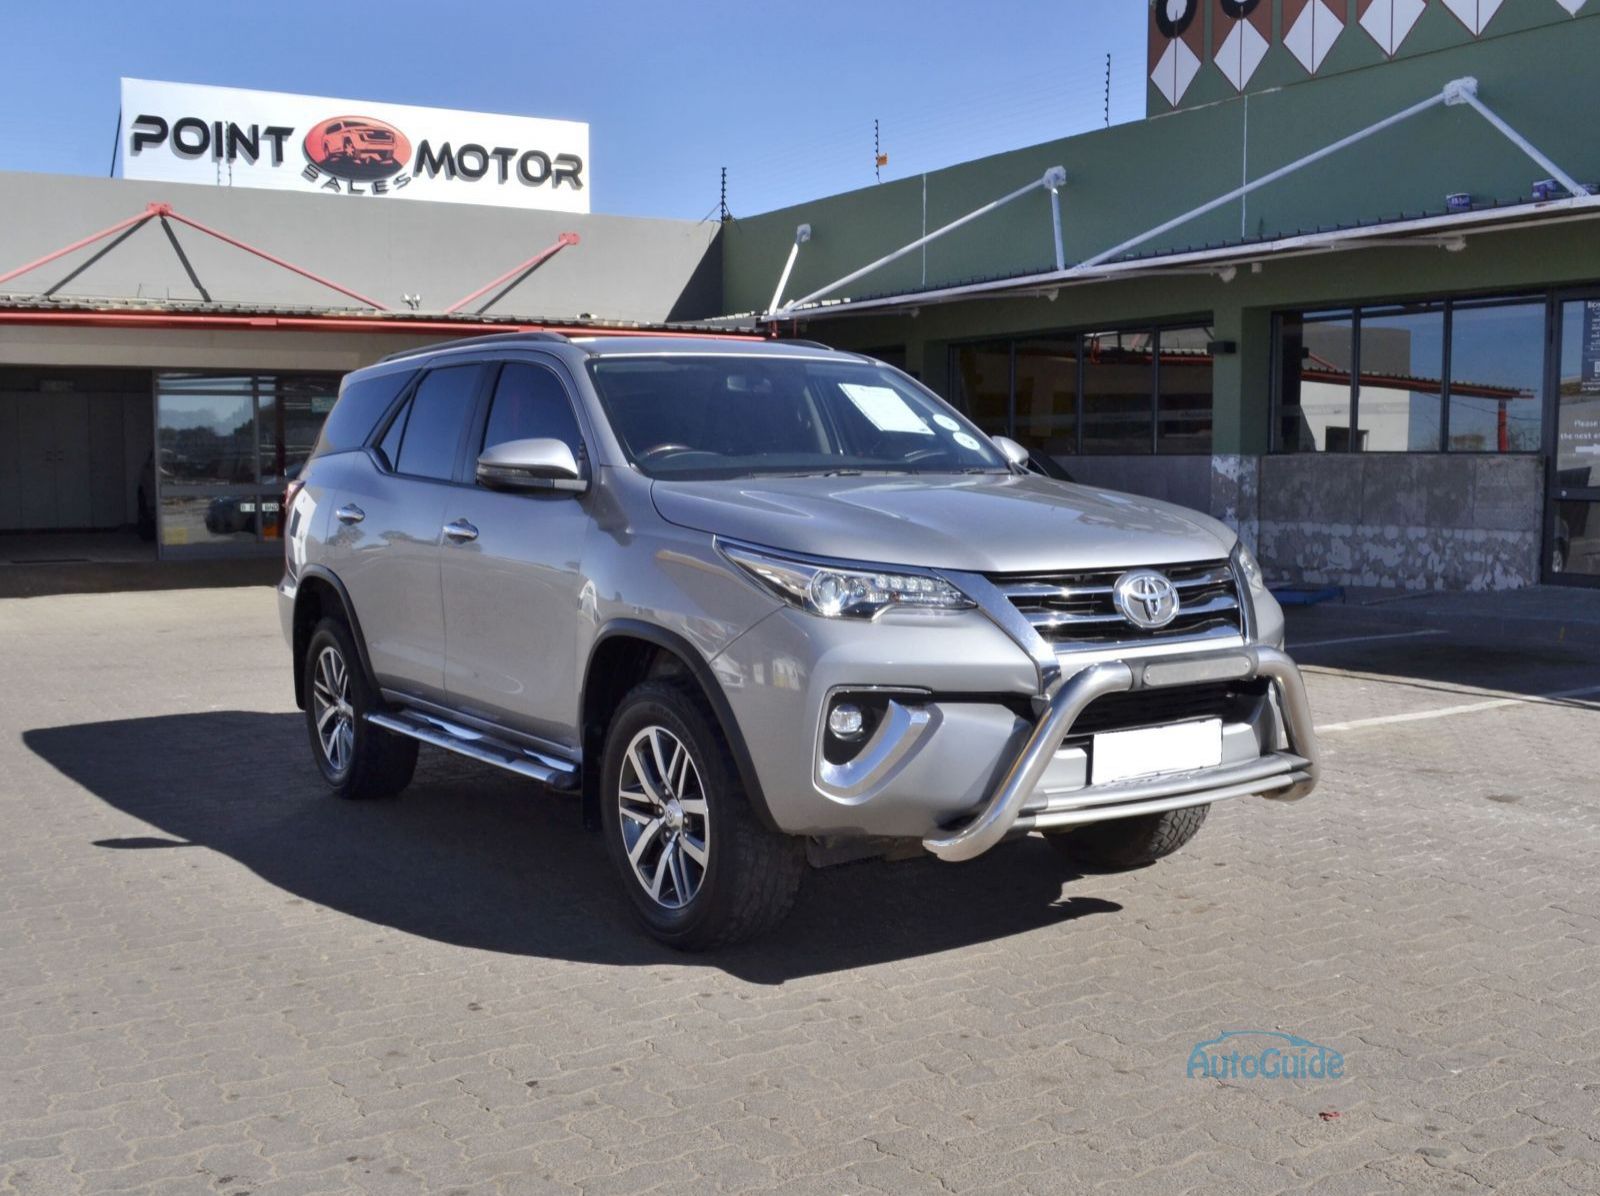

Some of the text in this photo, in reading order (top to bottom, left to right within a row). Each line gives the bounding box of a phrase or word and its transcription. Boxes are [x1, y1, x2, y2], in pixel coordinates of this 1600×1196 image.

[130, 113, 584, 191] POINT MOTOR
[302, 162, 412, 195] SALES
